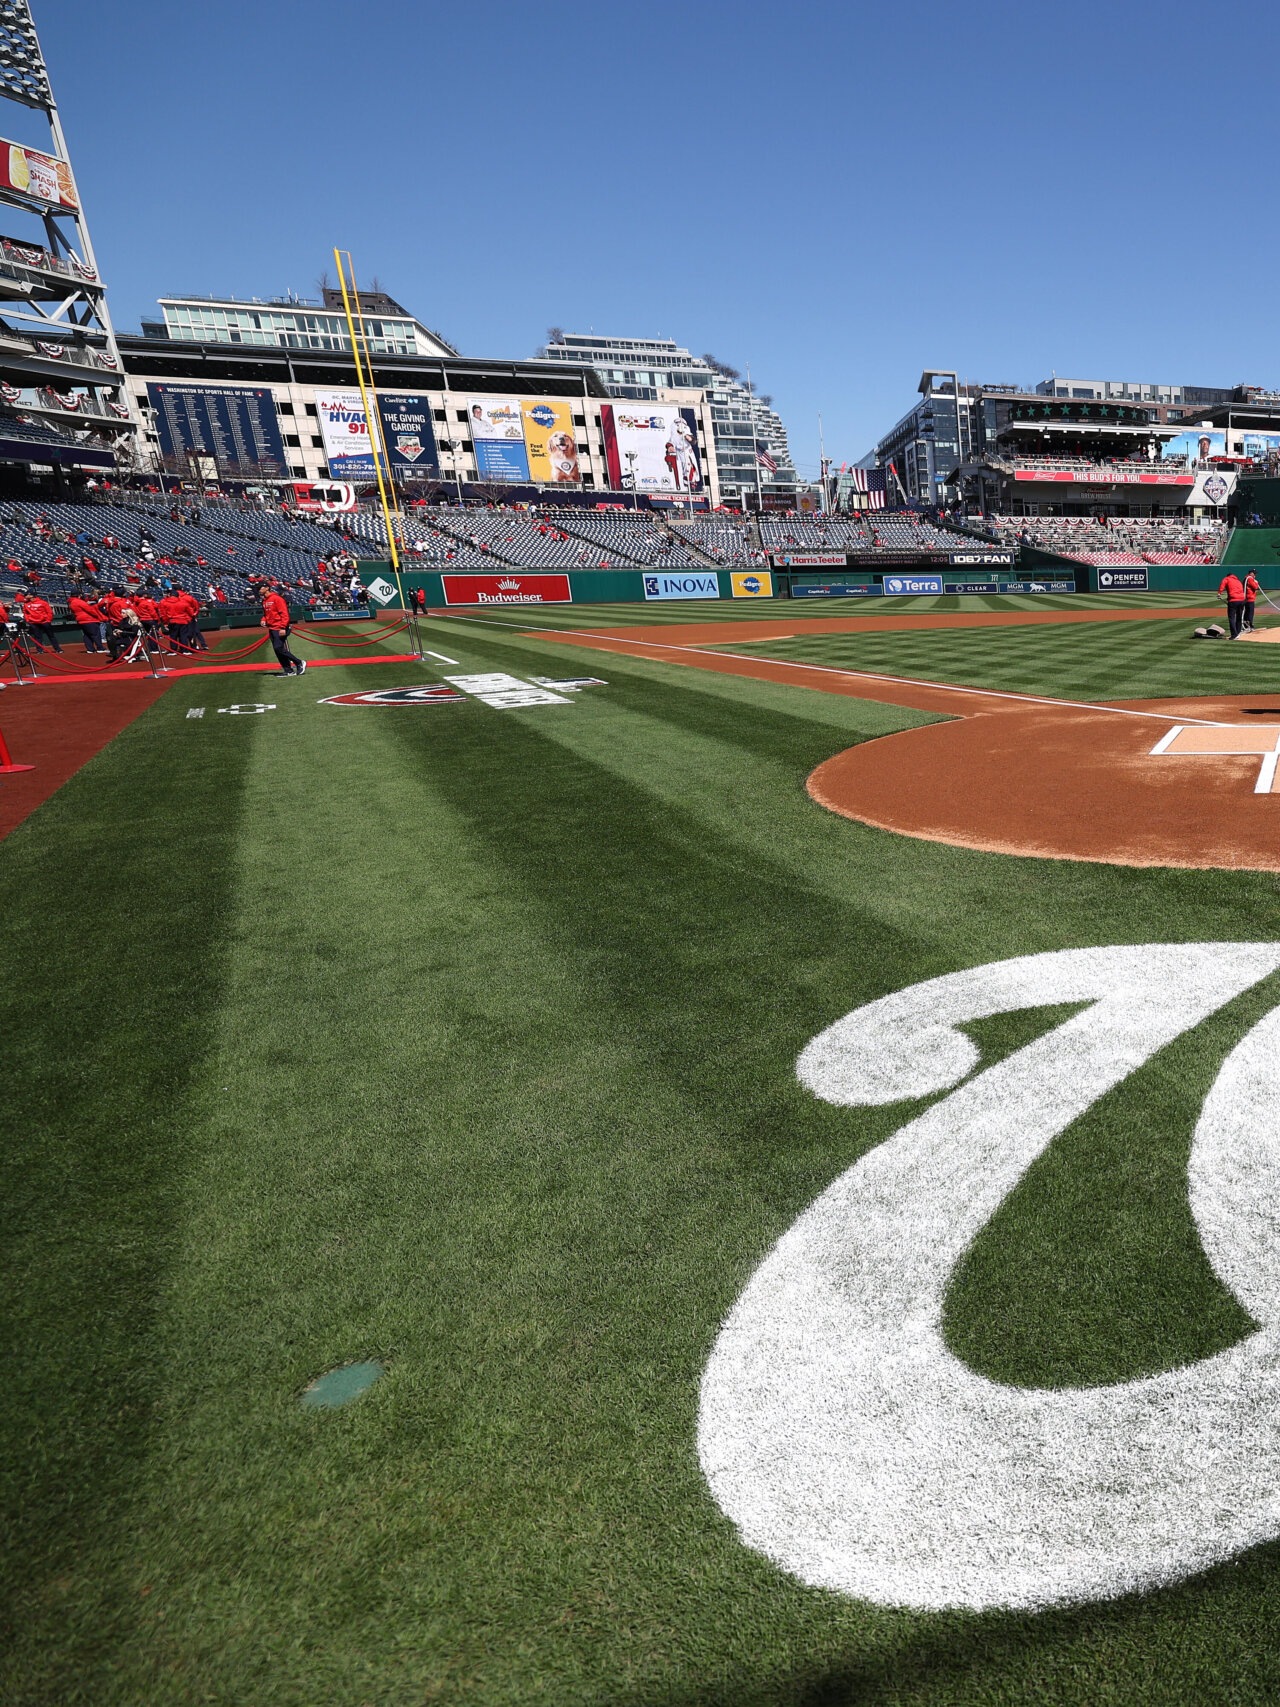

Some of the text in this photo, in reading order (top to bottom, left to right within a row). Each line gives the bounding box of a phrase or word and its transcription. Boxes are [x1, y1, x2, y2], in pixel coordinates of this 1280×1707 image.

[330, 411, 372, 423] HVAC
[383, 413, 426, 423] THE GIVING
[524, 410, 560, 420] Pedigree
[391, 422, 422, 432] GARDEN
[1072, 473, 1142, 482] THIS BUD'S FOR YOU.
[663, 579, 717, 593] INOVA
[903, 580, 938, 591] Terra
